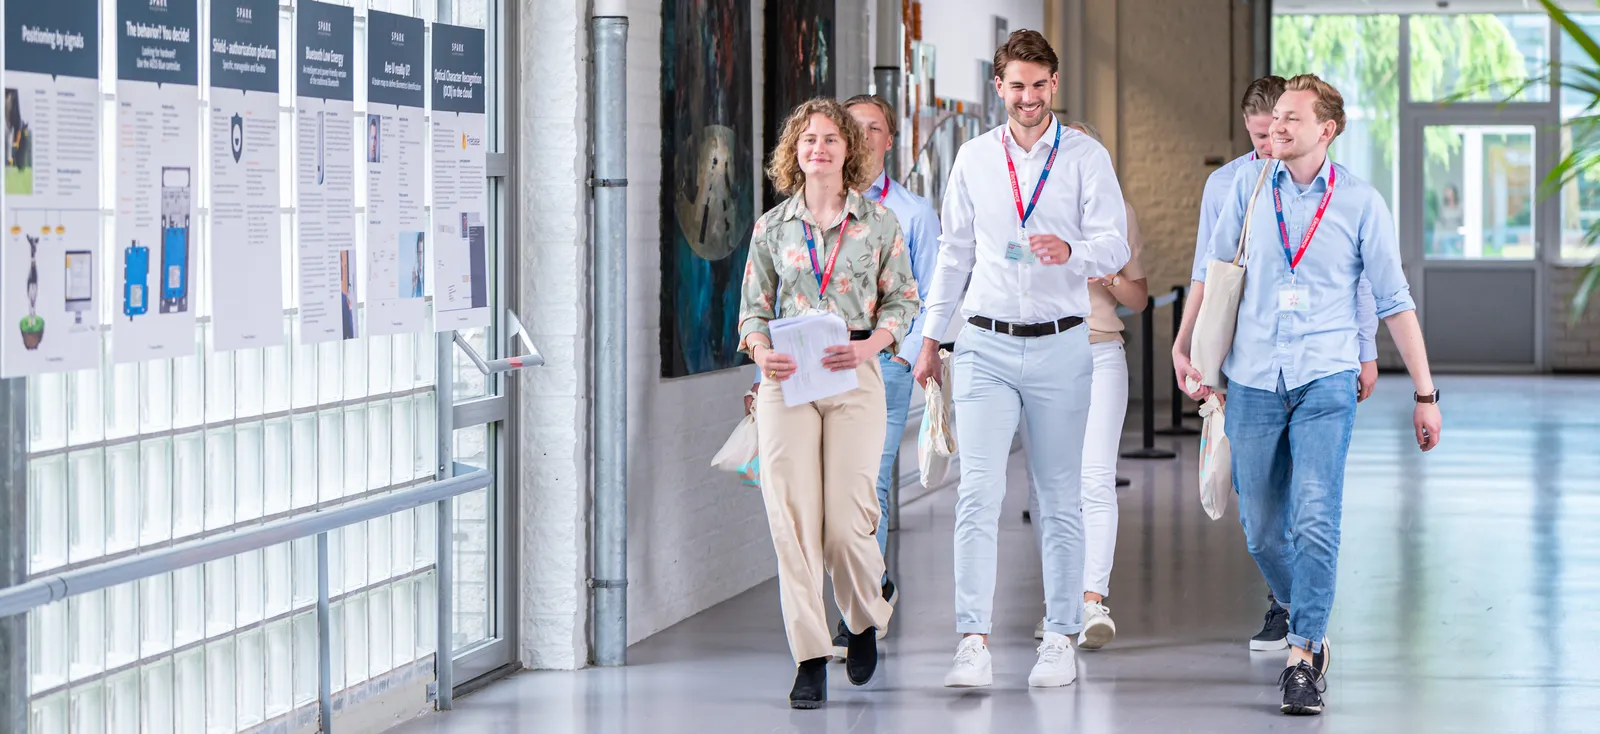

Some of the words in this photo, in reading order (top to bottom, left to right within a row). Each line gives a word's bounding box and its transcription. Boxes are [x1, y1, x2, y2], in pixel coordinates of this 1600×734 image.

[236, 7, 252, 19] SPARK
[126, 20, 137, 37] The
[137, 22, 162, 40] behavior?
[162, 24, 172, 41] You
[172, 26, 190, 43] decide!
[318, 21, 331, 32] SPARK
[391, 32, 404, 42] SPARK
[22, 24, 56, 50] Positioning
[56, 29, 64, 51] by
[64, 31, 84, 52] signals
[451, 42, 464, 52] SPARK
[212, 38, 227, 54] Shield
[228, 41, 257, 58] authorization
[257, 44, 276, 61] platform
[306, 46, 323, 61] Bluetooth
[322, 48, 331, 62] Low
[330, 50, 345, 67] Energy
[395, 63, 405, 79] really
[434, 68, 446, 83] Optical
[446, 70, 462, 82] Character
[461, 71, 482, 86] Recognition
[462, 86, 473, 99] cloud
[1045, 148, 1058, 171] GROWTH
[1009, 170, 1021, 203] EXCELLENCE
[1273, 187, 1282, 212] GROWTH
[1301, 217, 1319, 249] EXCELLENCE
